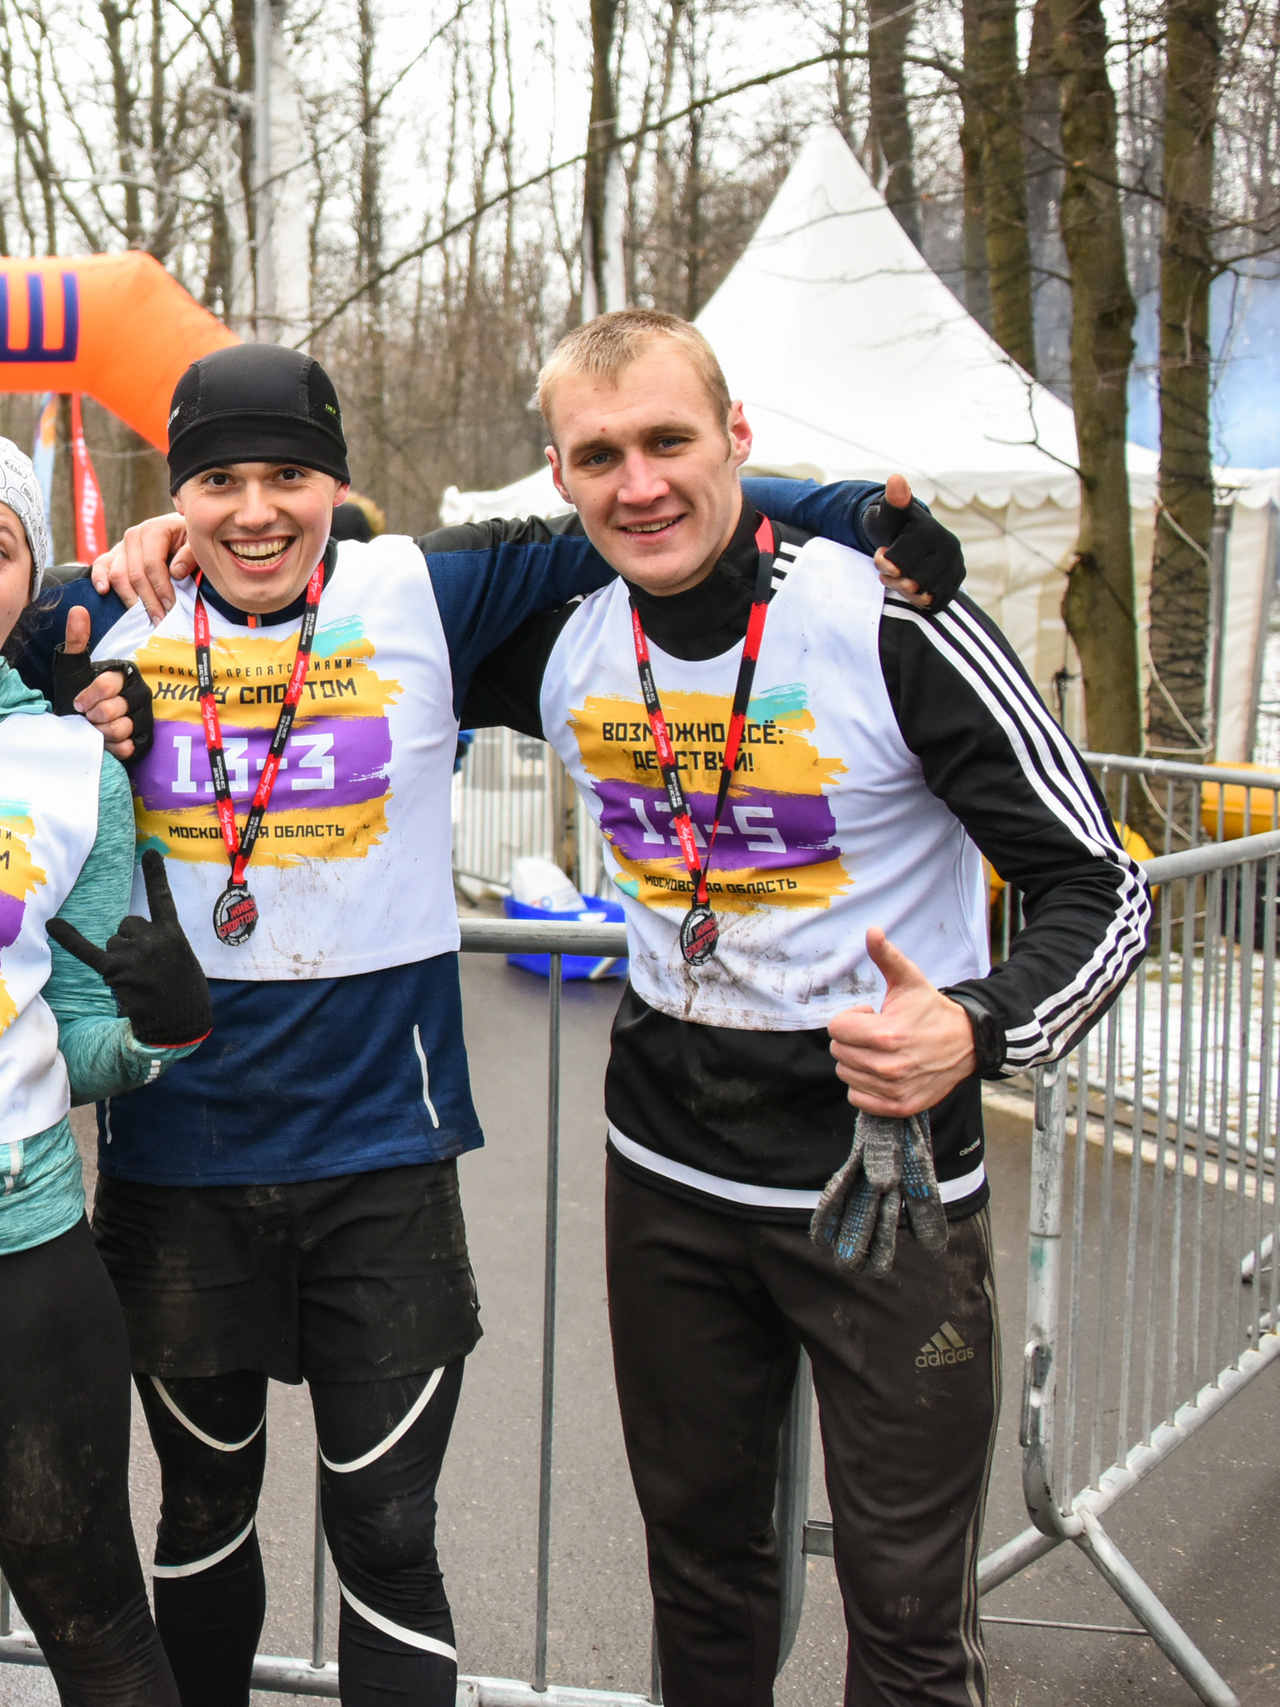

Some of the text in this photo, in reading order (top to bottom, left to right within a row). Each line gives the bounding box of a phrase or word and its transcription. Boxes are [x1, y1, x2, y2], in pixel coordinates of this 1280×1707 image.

[159, 657, 352, 679] ГОНК С ПРЕПЯТСИЯМИ
[153, 677, 357, 705] ЖИУ СПОТОМ
[171, 733, 335, 793] 13-3
[632, 747, 755, 772] ДЕСТВЙ!
[168, 824, 345, 840] МОСКОКЯ ОБЛАСТЬ
[629, 797, 787, 854] 13-5
[643, 873, 798, 895] МОСКОВСАЯ ОБЛАСТЬ
[915, 1346, 975, 1369] adidas
